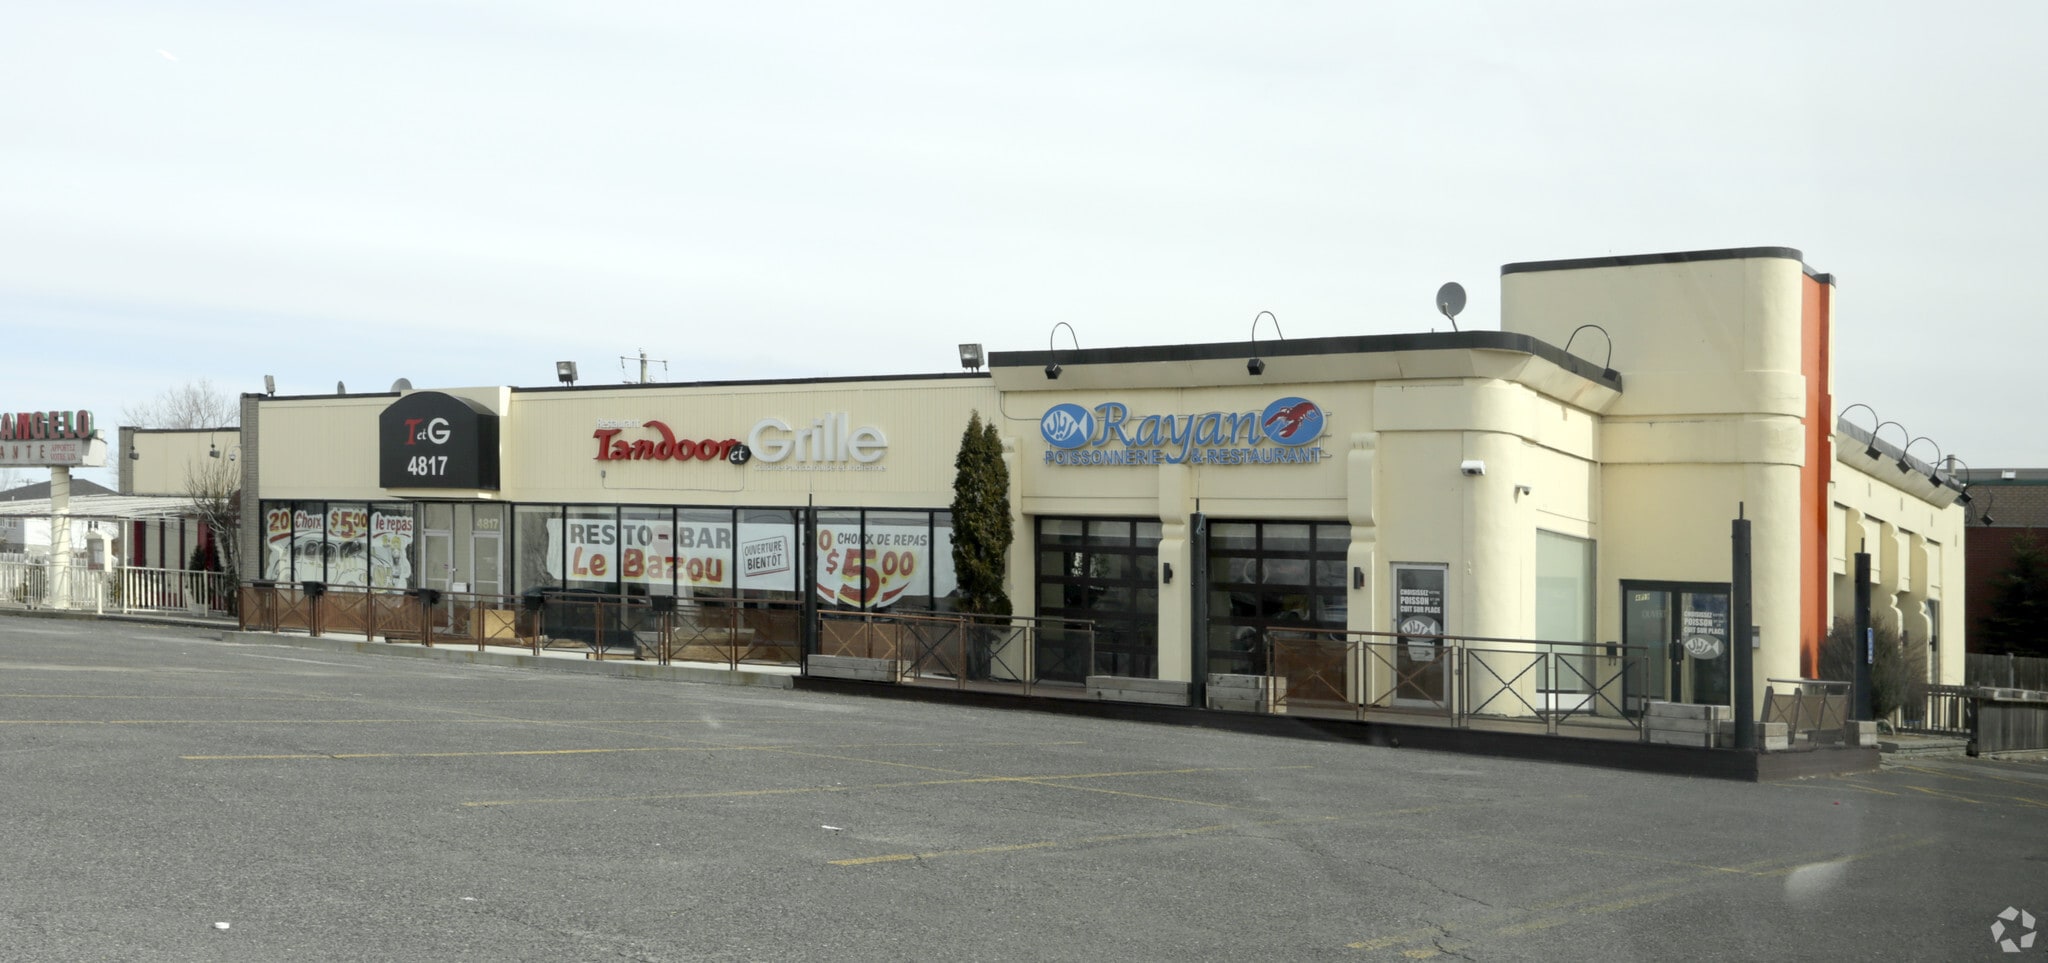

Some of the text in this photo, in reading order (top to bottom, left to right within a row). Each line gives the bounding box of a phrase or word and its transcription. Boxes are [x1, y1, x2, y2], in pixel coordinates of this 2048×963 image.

[0, 410, 93, 440] ANGELO
[1091, 402, 1263, 465] Rayan
[593, 411, 889, 464] Tandoor et Grille
[1044, 447, 1322, 465] POISSONNERIE & RESTAURANT
[407, 455, 449, 476] 4817
[269, 511, 290, 532] 20
[295, 511, 322, 530] Choix
[386, 517, 412, 535] repas
[477, 518, 499, 529] 4817
[744, 540, 782, 557] OUVERTURE
[837, 532, 874, 546] CHOIX
[876, 533, 890, 546] DE
[894, 533, 928, 547] REPAS
[573, 546, 723, 583] Le Bazou
[747, 552, 782, 571] BIENTÔT
[1400, 596, 1429, 605] POISSON
[1400, 605, 1412, 613] CUIT
[1425, 606, 1441, 614] PLACE
[1684, 618, 1712, 627] POISSON
[1708, 627, 1725, 635] PLACE
